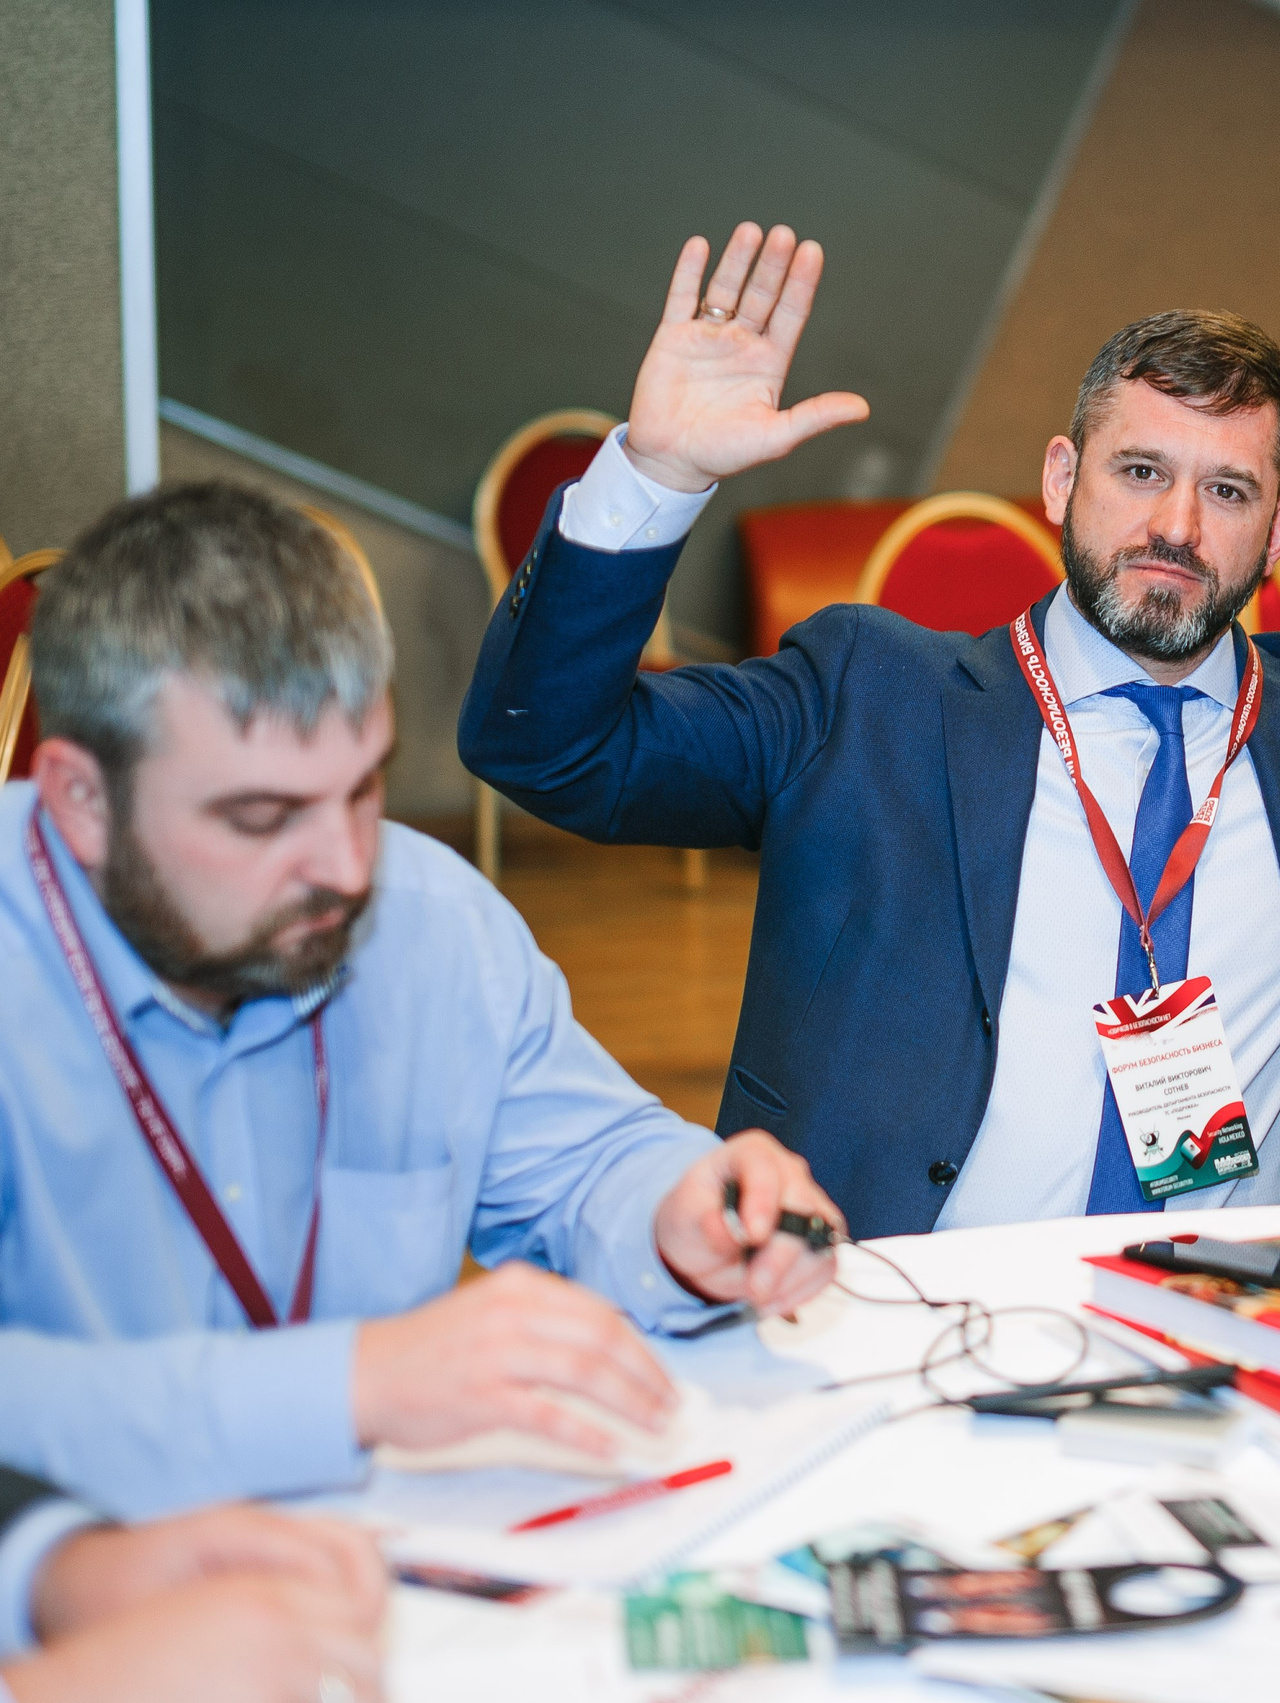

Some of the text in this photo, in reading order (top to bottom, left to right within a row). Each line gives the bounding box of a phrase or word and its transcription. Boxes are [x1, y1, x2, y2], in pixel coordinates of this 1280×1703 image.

[1015, 612, 1035, 656] БИЗНЕС
[1026, 655, 1074, 762] БЕЗОПАСНОСТЬ
[1235, 704, 1252, 742] РАБОТАТЬ
[1112, 1039, 1223, 1074] ФОРУМ БЕЗОПАСНОСТЬ БИЗНЕСА
[1135, 1065, 1212, 1092] ВИТАЛИЙ ВИКТОРОВИЧ
[1163, 1084, 1189, 1096] СОТНЕВ
[1128, 1085, 1231, 1117] РУКОВОДИТЕЛЬ ДЕПАРТАМЕНТА БЕЗОПАСНОСТИ
